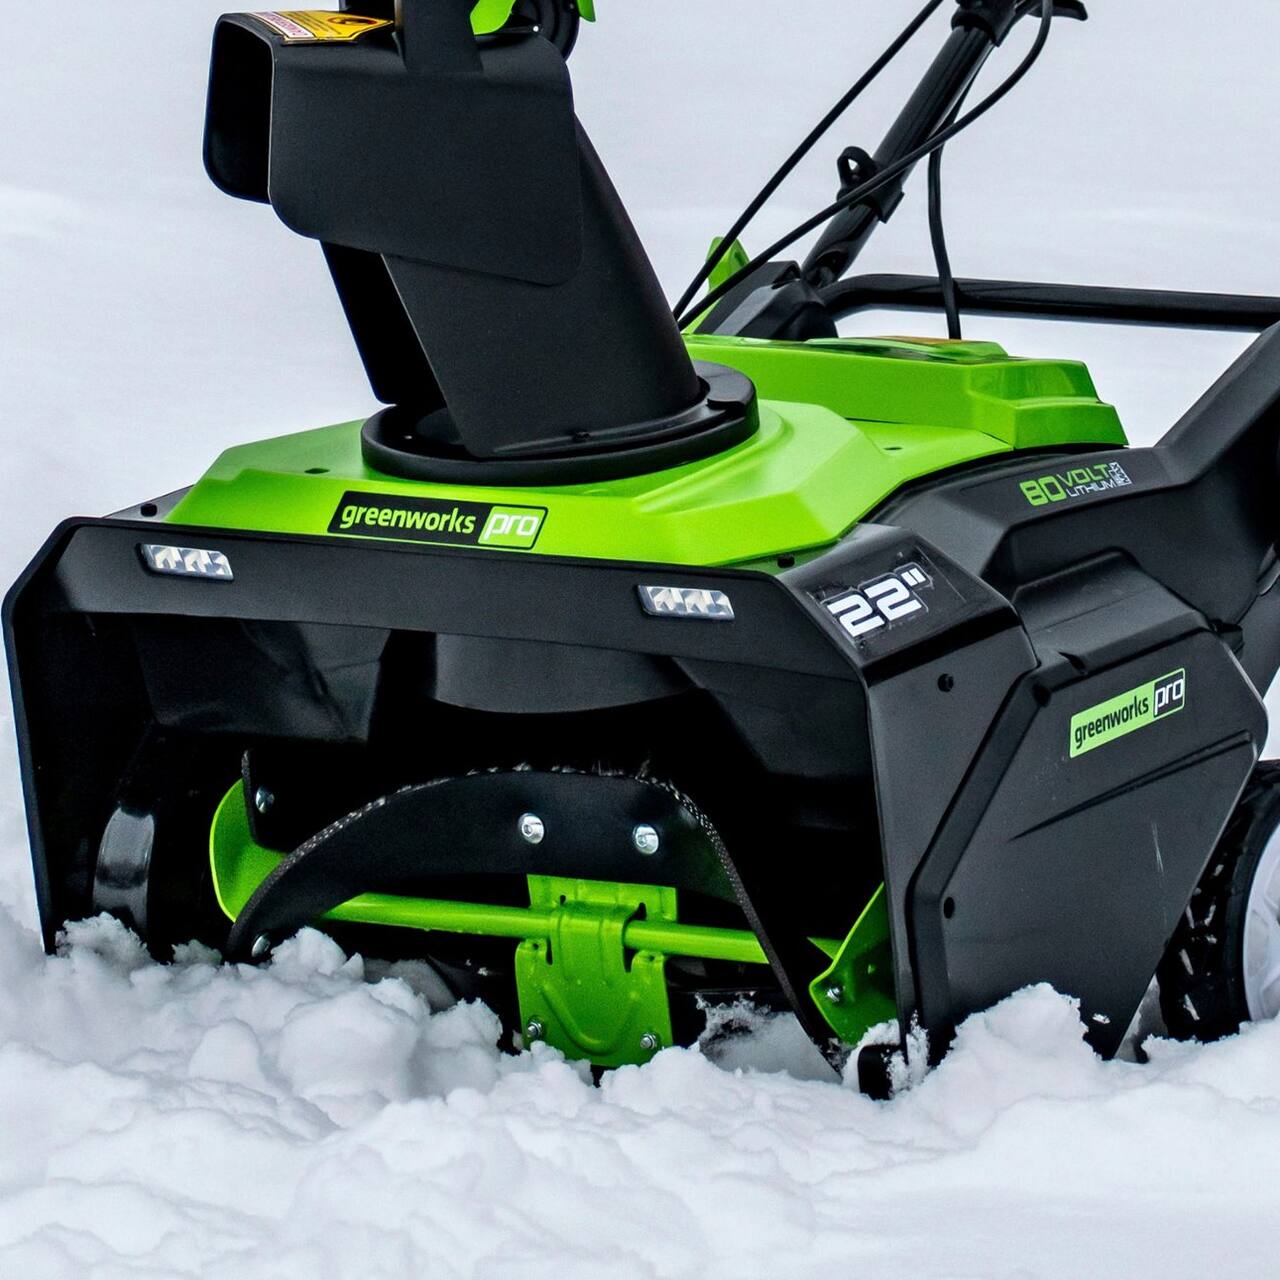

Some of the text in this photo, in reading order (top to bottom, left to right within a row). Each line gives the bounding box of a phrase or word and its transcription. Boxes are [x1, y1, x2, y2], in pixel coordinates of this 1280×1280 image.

[1019, 464, 1110, 506] 80 VOLT
[1066, 479, 1117, 497] LITHIUM
[340, 505, 540, 540] greenworks pro
[826, 567, 927, 637] 22"
[1074, 679, 1183, 749] greenworks pro
